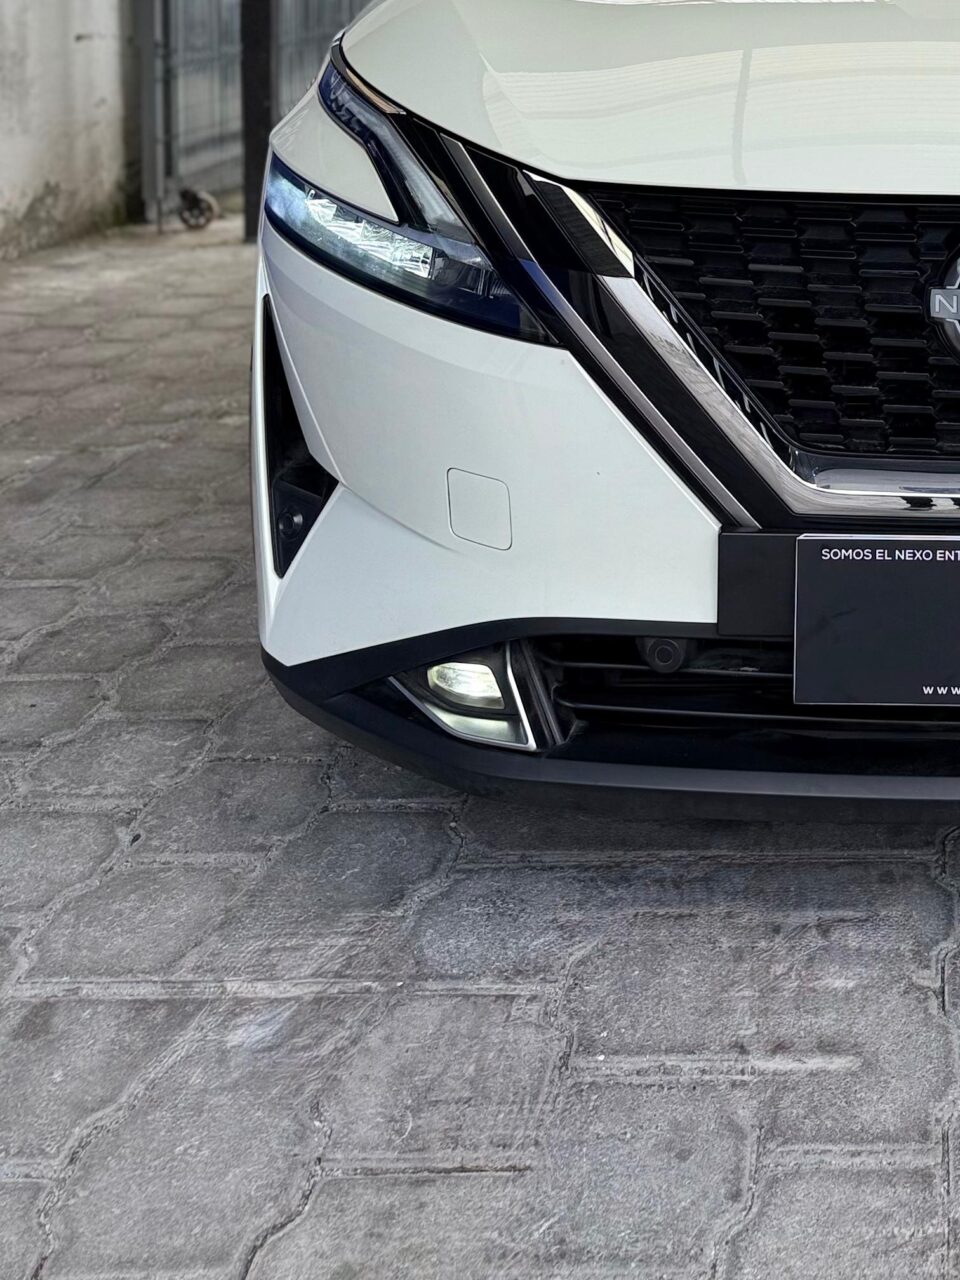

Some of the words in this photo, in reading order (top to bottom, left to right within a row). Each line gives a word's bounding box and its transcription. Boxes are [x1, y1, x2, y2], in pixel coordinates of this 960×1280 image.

[821, 548, 873, 561] SOMOS
[875, 548, 893, 561] EL
[895, 549, 934, 562] NEXO
